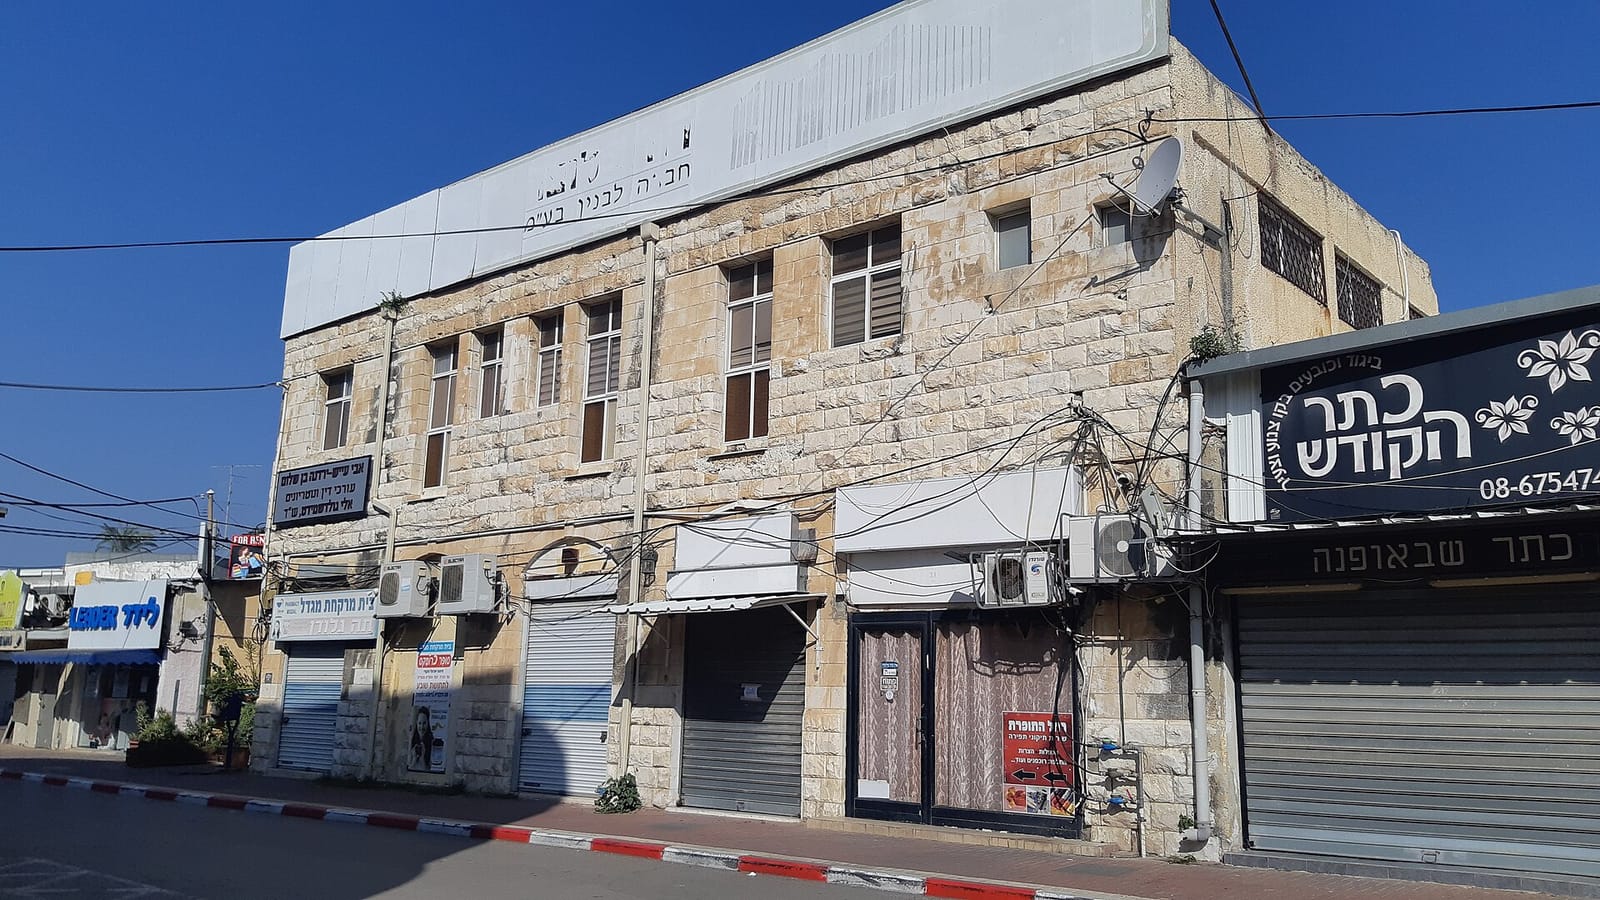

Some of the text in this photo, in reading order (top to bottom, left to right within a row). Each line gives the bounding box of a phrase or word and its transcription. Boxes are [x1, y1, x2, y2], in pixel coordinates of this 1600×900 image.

[637, 163, 690, 194] חבה
[578, 183, 623, 218] לבנין
[1346, 354, 1382, 369] ביגוד
[1289, 360, 1341, 393] וכובעים
[1272, 394, 1293, 419] בקו
[1303, 374, 1424, 432] כתר
[1266, 420, 1281, 452] צנוע
[1297, 410, 1472, 480] הקודש
[281, 472, 300, 487] שלום
[300, 472, 308, 486] בן
[351, 462, 364, 475] אבי
[1267, 453, 1291, 492] וצעיר
[285, 483, 356, 502] עורכי דין ונוטריונים
[341, 497, 353, 511] אלי
[233, 535, 266, 545] FOR REN
[1313, 533, 1573, 573] כתר שבאופנה
[122, 596, 160, 629] לידר
[300, 597, 322, 613] מגדל
[324, 598, 356, 616] מרקחת
[69, 604, 119, 631] LEADER
[1008, 720, 1045, 732] התופרת
[1029, 734, 1047, 742] תיקוני
